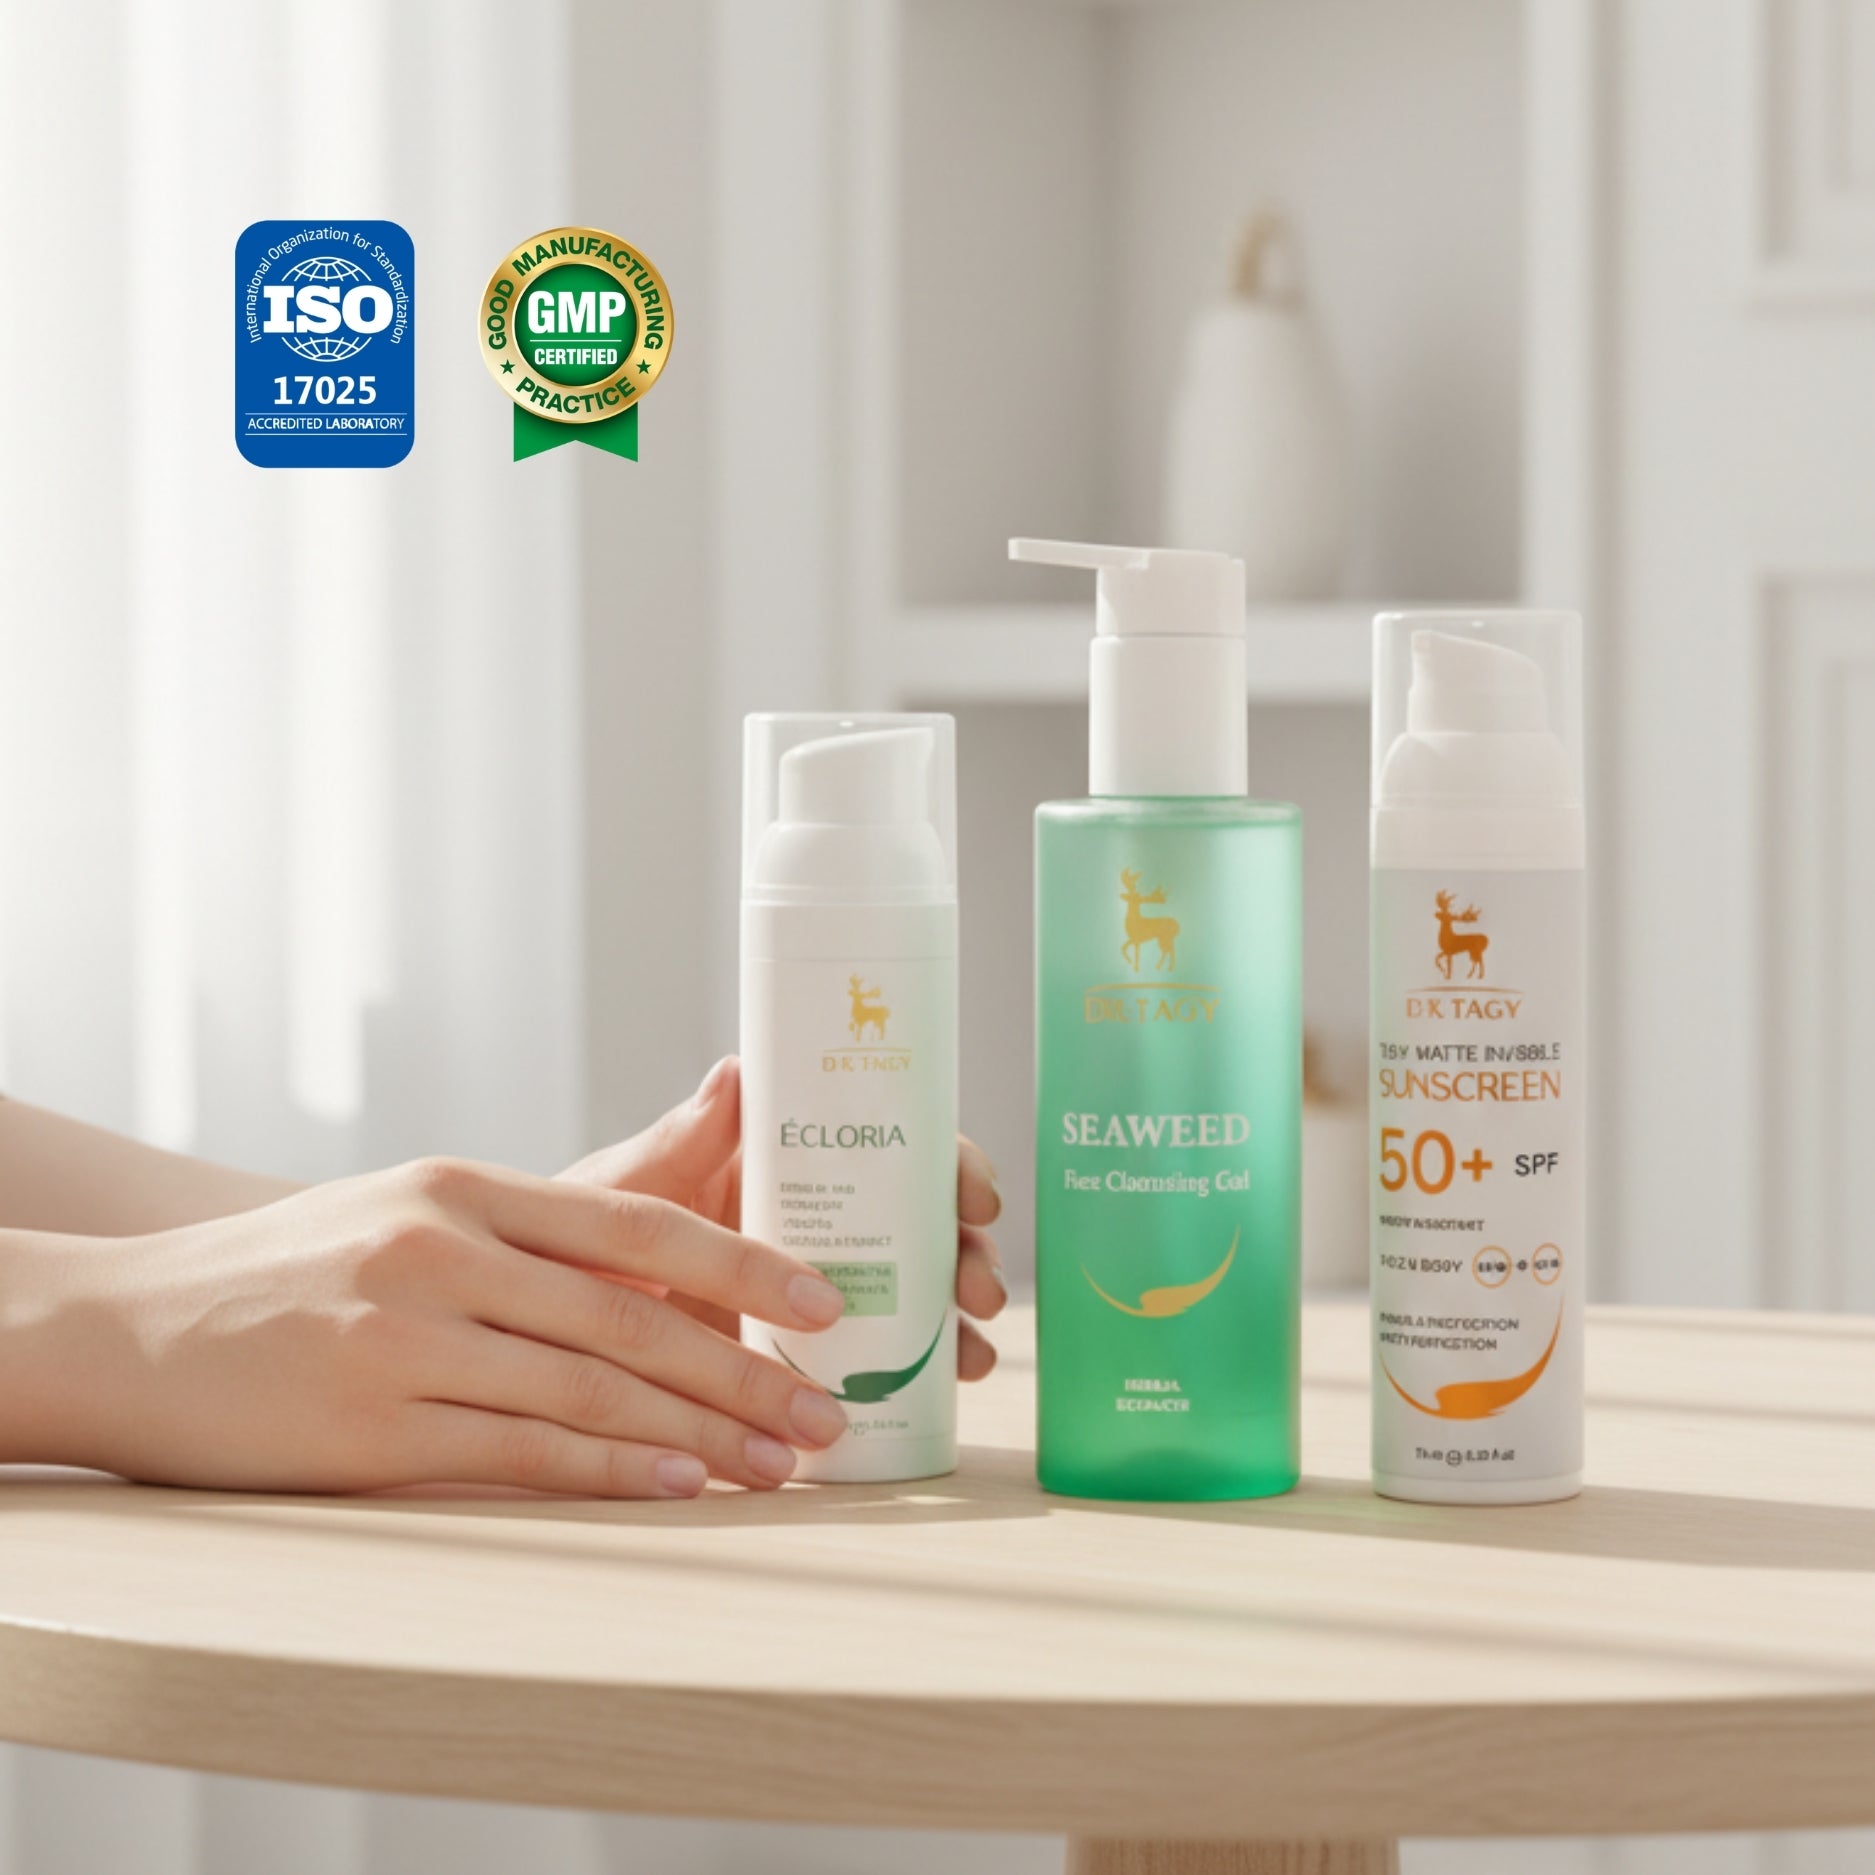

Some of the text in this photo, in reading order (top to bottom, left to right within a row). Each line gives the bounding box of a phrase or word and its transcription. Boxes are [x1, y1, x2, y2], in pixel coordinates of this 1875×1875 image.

[1451, 998, 1523, 1020] TAGY
[1379, 1067, 1562, 1101] SUNSCREEN
[780, 1118, 907, 1149] ÉCLORIA
[1062, 1112, 1251, 1148] SEAWEED
[1379, 1127, 1560, 1196] 50+ SPF
